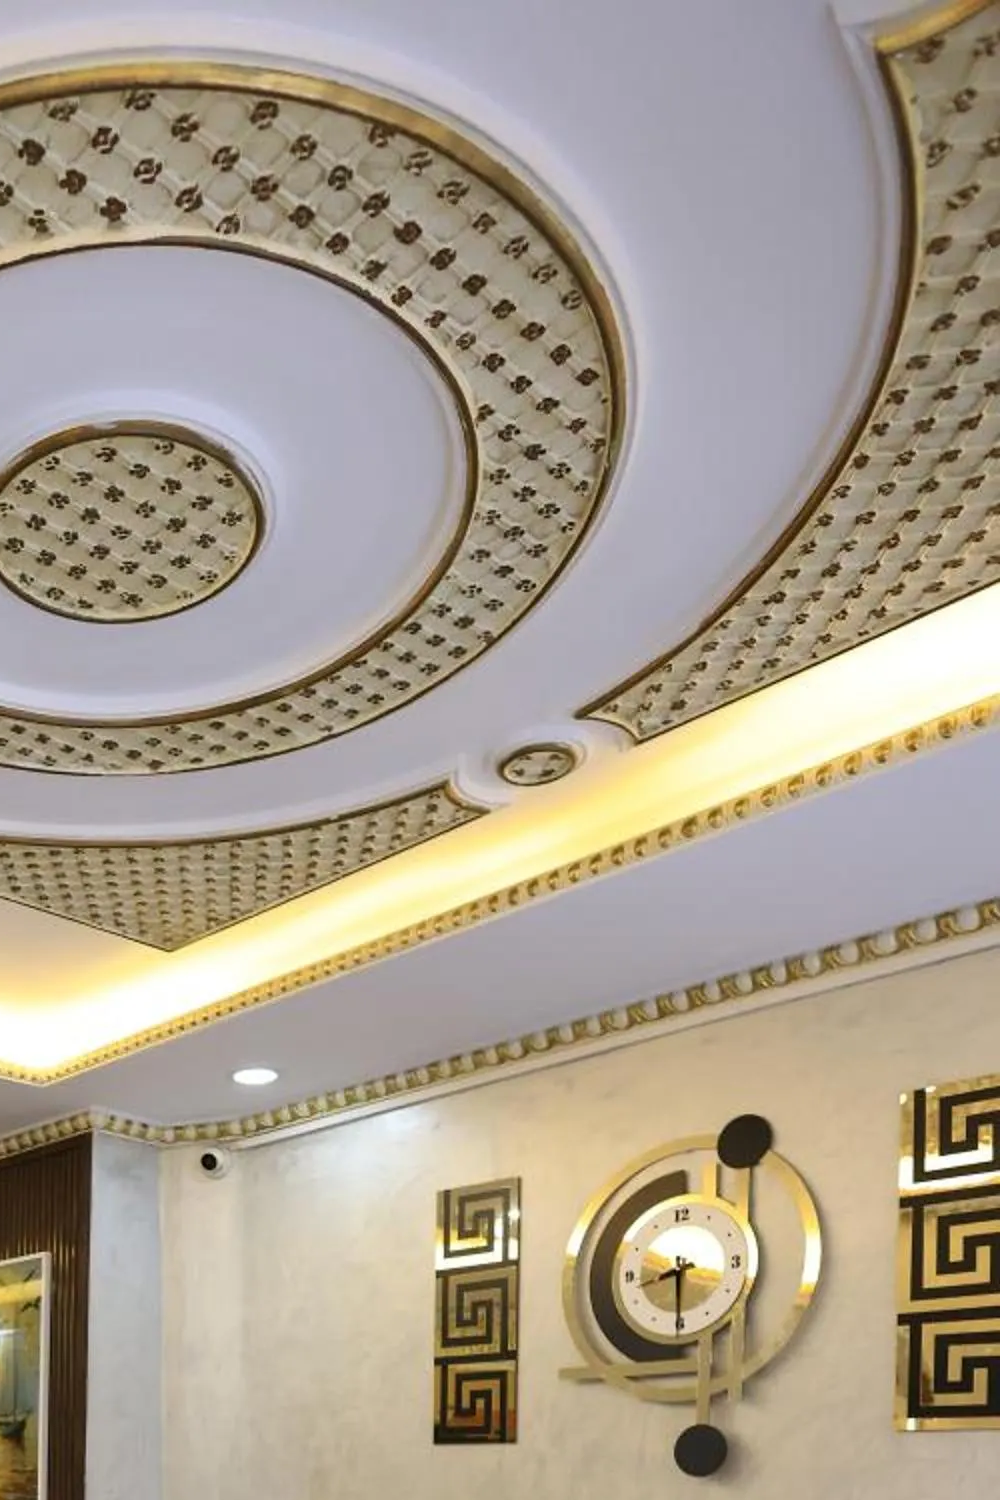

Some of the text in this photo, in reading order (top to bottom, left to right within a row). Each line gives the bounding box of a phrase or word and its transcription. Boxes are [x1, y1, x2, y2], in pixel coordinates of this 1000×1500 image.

[674, 1206, 690, 1223] 12
[731, 1255, 741, 1269] 3
[625, 1270, 635, 1284] 9
[675, 1317, 685, 1330] 6
